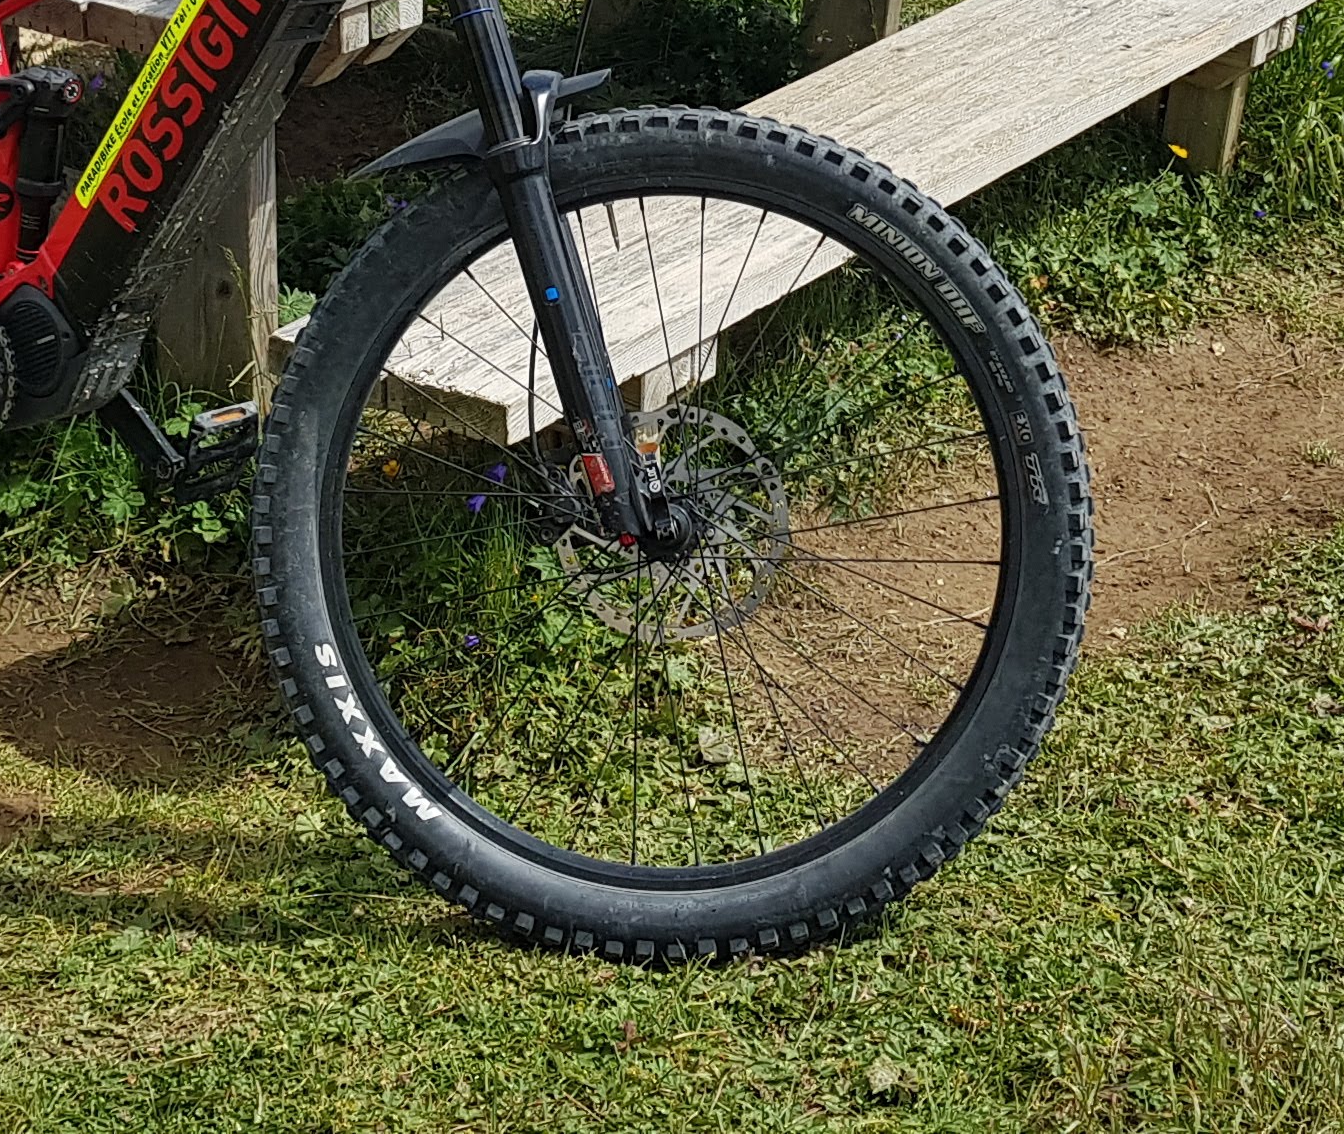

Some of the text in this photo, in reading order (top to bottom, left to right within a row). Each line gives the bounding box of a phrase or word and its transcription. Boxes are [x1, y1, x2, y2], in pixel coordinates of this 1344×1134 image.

[79, 133, 119, 197] PARADIBIKE
[114, 108, 132, 136] École
[131, 93, 140, 107] et
[137, 53, 164, 95] Location
[160, 25, 175, 50] VTT
[846, 203, 986, 333] MINION DHF
[1015, 410, 1033, 444] EXO
[314, 642, 444, 822] MAXXIS
